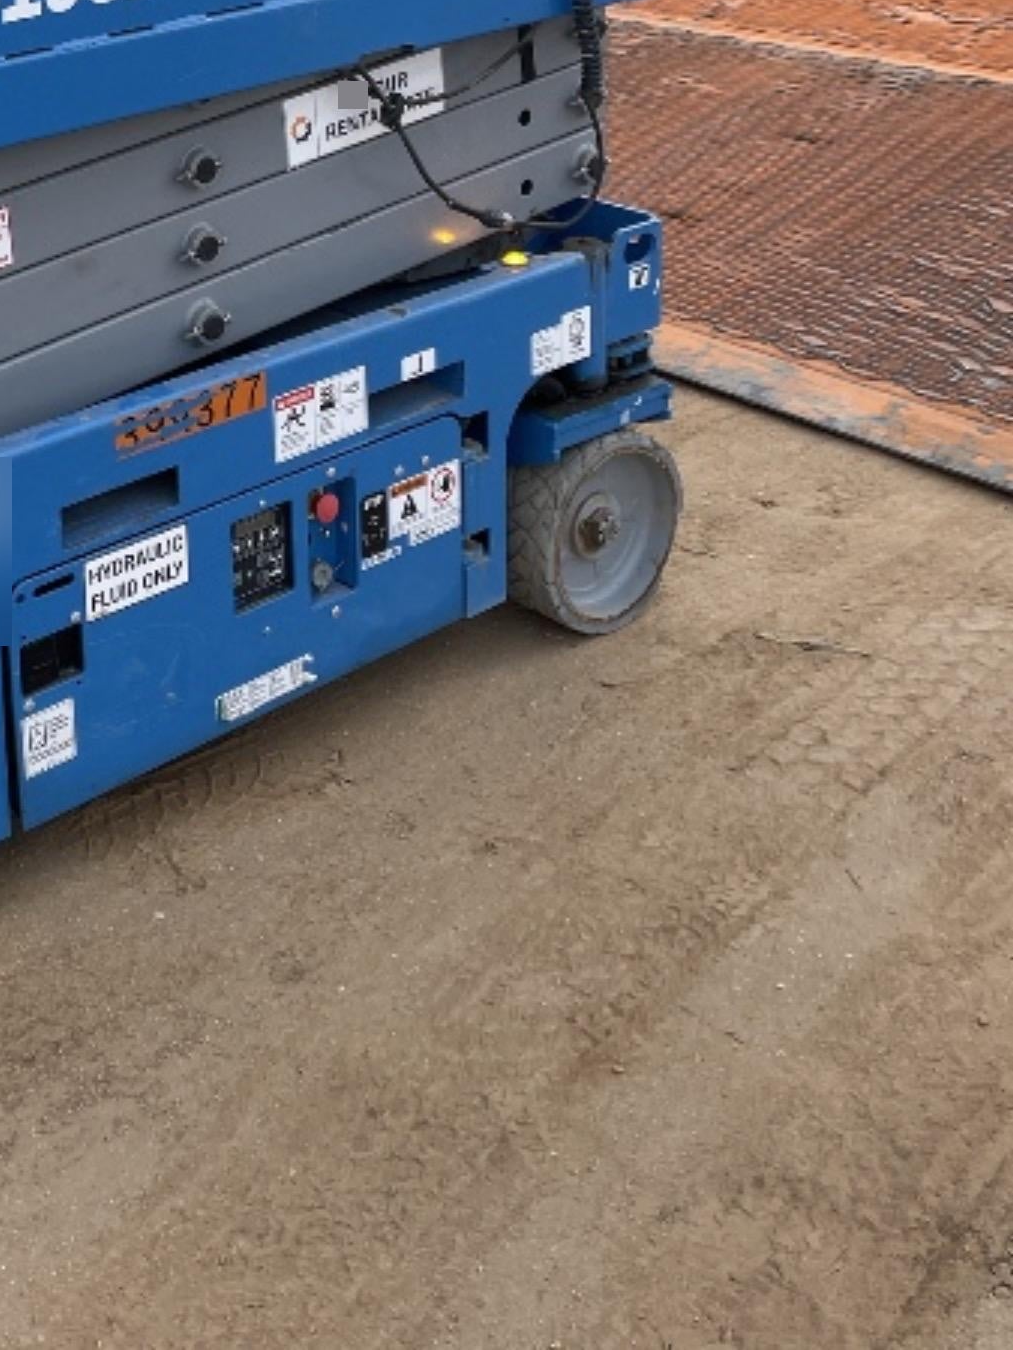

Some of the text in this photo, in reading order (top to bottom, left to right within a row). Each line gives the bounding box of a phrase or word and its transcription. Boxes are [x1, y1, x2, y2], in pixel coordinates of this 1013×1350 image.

[325, 106, 385, 141] RENTA
[89, 534, 183, 586] HYDRAULIC
[92, 560, 183, 612] FLUID ONLY
